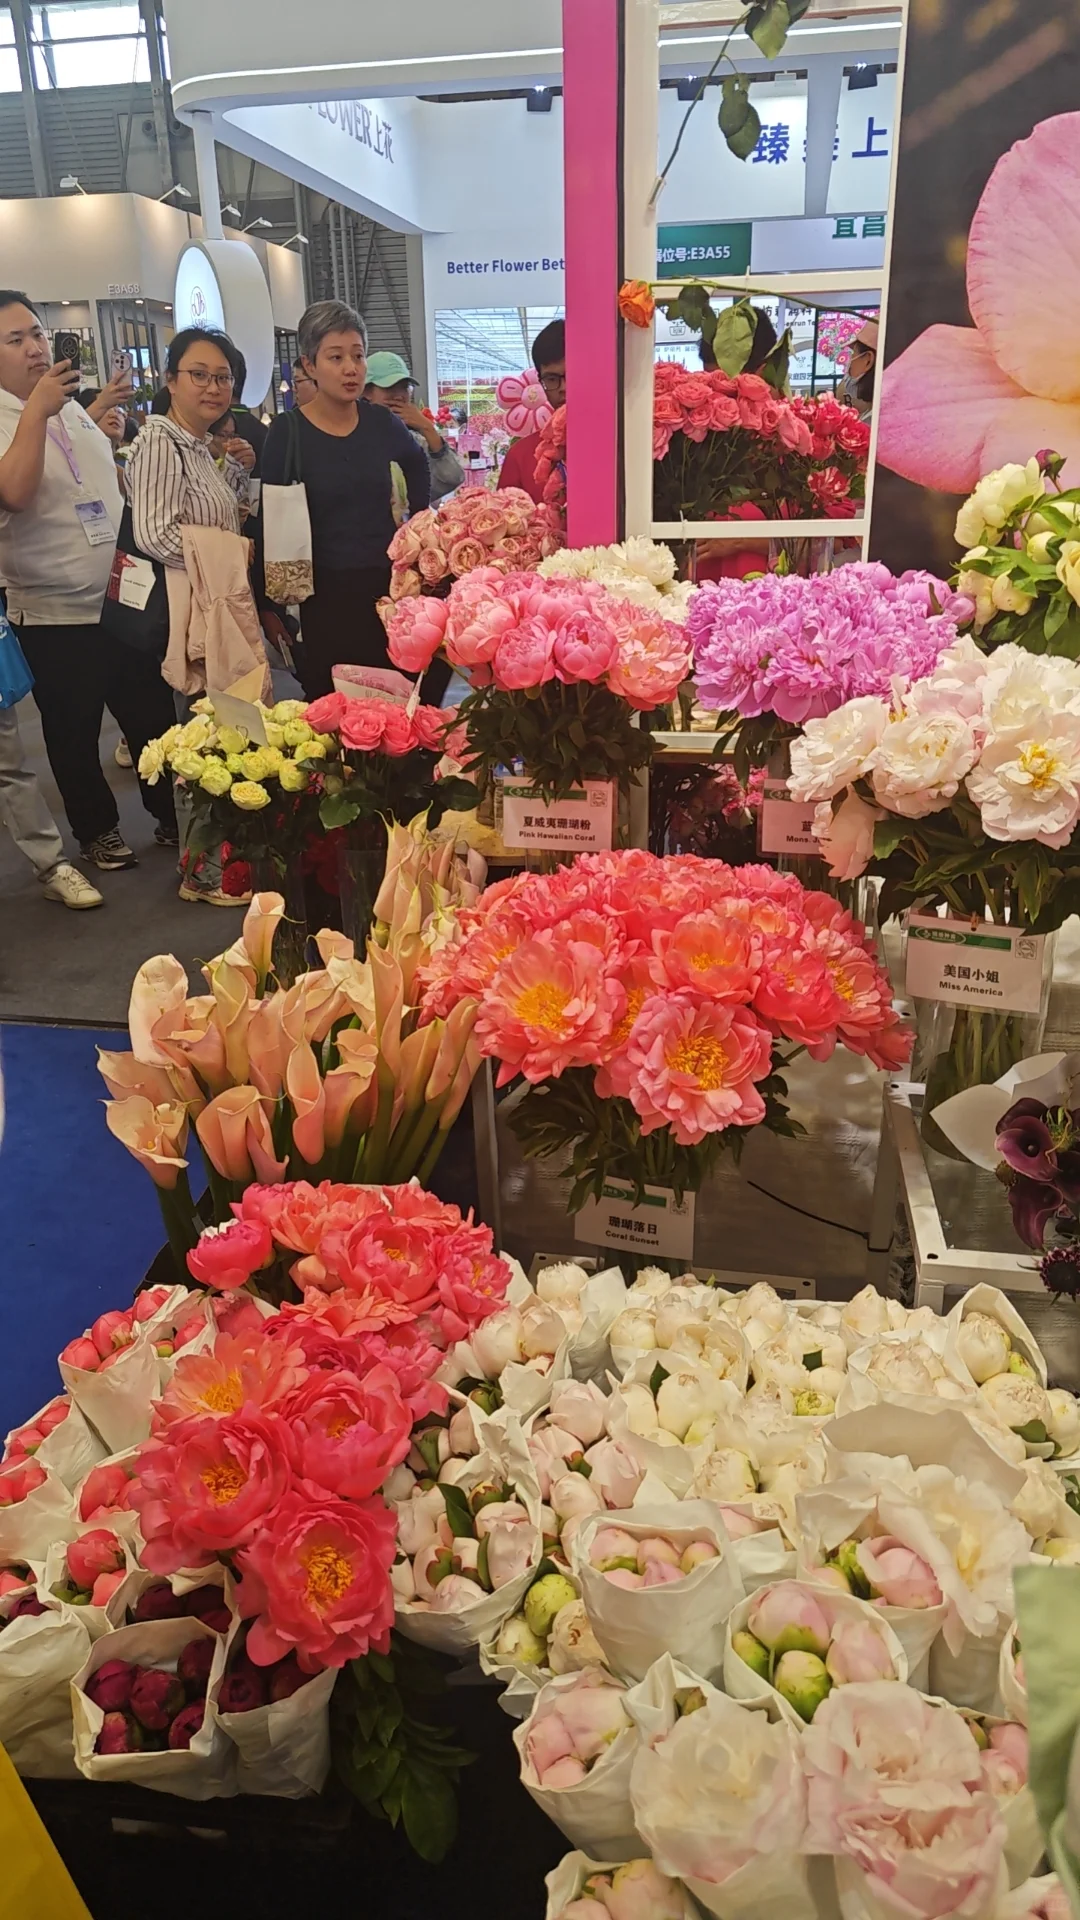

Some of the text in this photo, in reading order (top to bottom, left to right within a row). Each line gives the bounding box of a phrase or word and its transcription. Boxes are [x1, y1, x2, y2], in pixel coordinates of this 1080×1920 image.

[308, 101, 372, 149] LOWER
[447, 261, 489, 274] Better
[492, 259, 539, 273] Flower
[107, 284, 140, 295] E3A58
[523, 816, 591, 831] 夏威夷珊瑚粉
[519, 830, 536, 838] Pink
[786, 835, 810, 843] Mons.
[943, 964, 1000, 983] 美国小姐
[939, 980, 1004, 997] Miss America
[608, 1215, 658, 1235] 珊瑚落日
[605, 1230, 660, 1246] Coral Sunset
